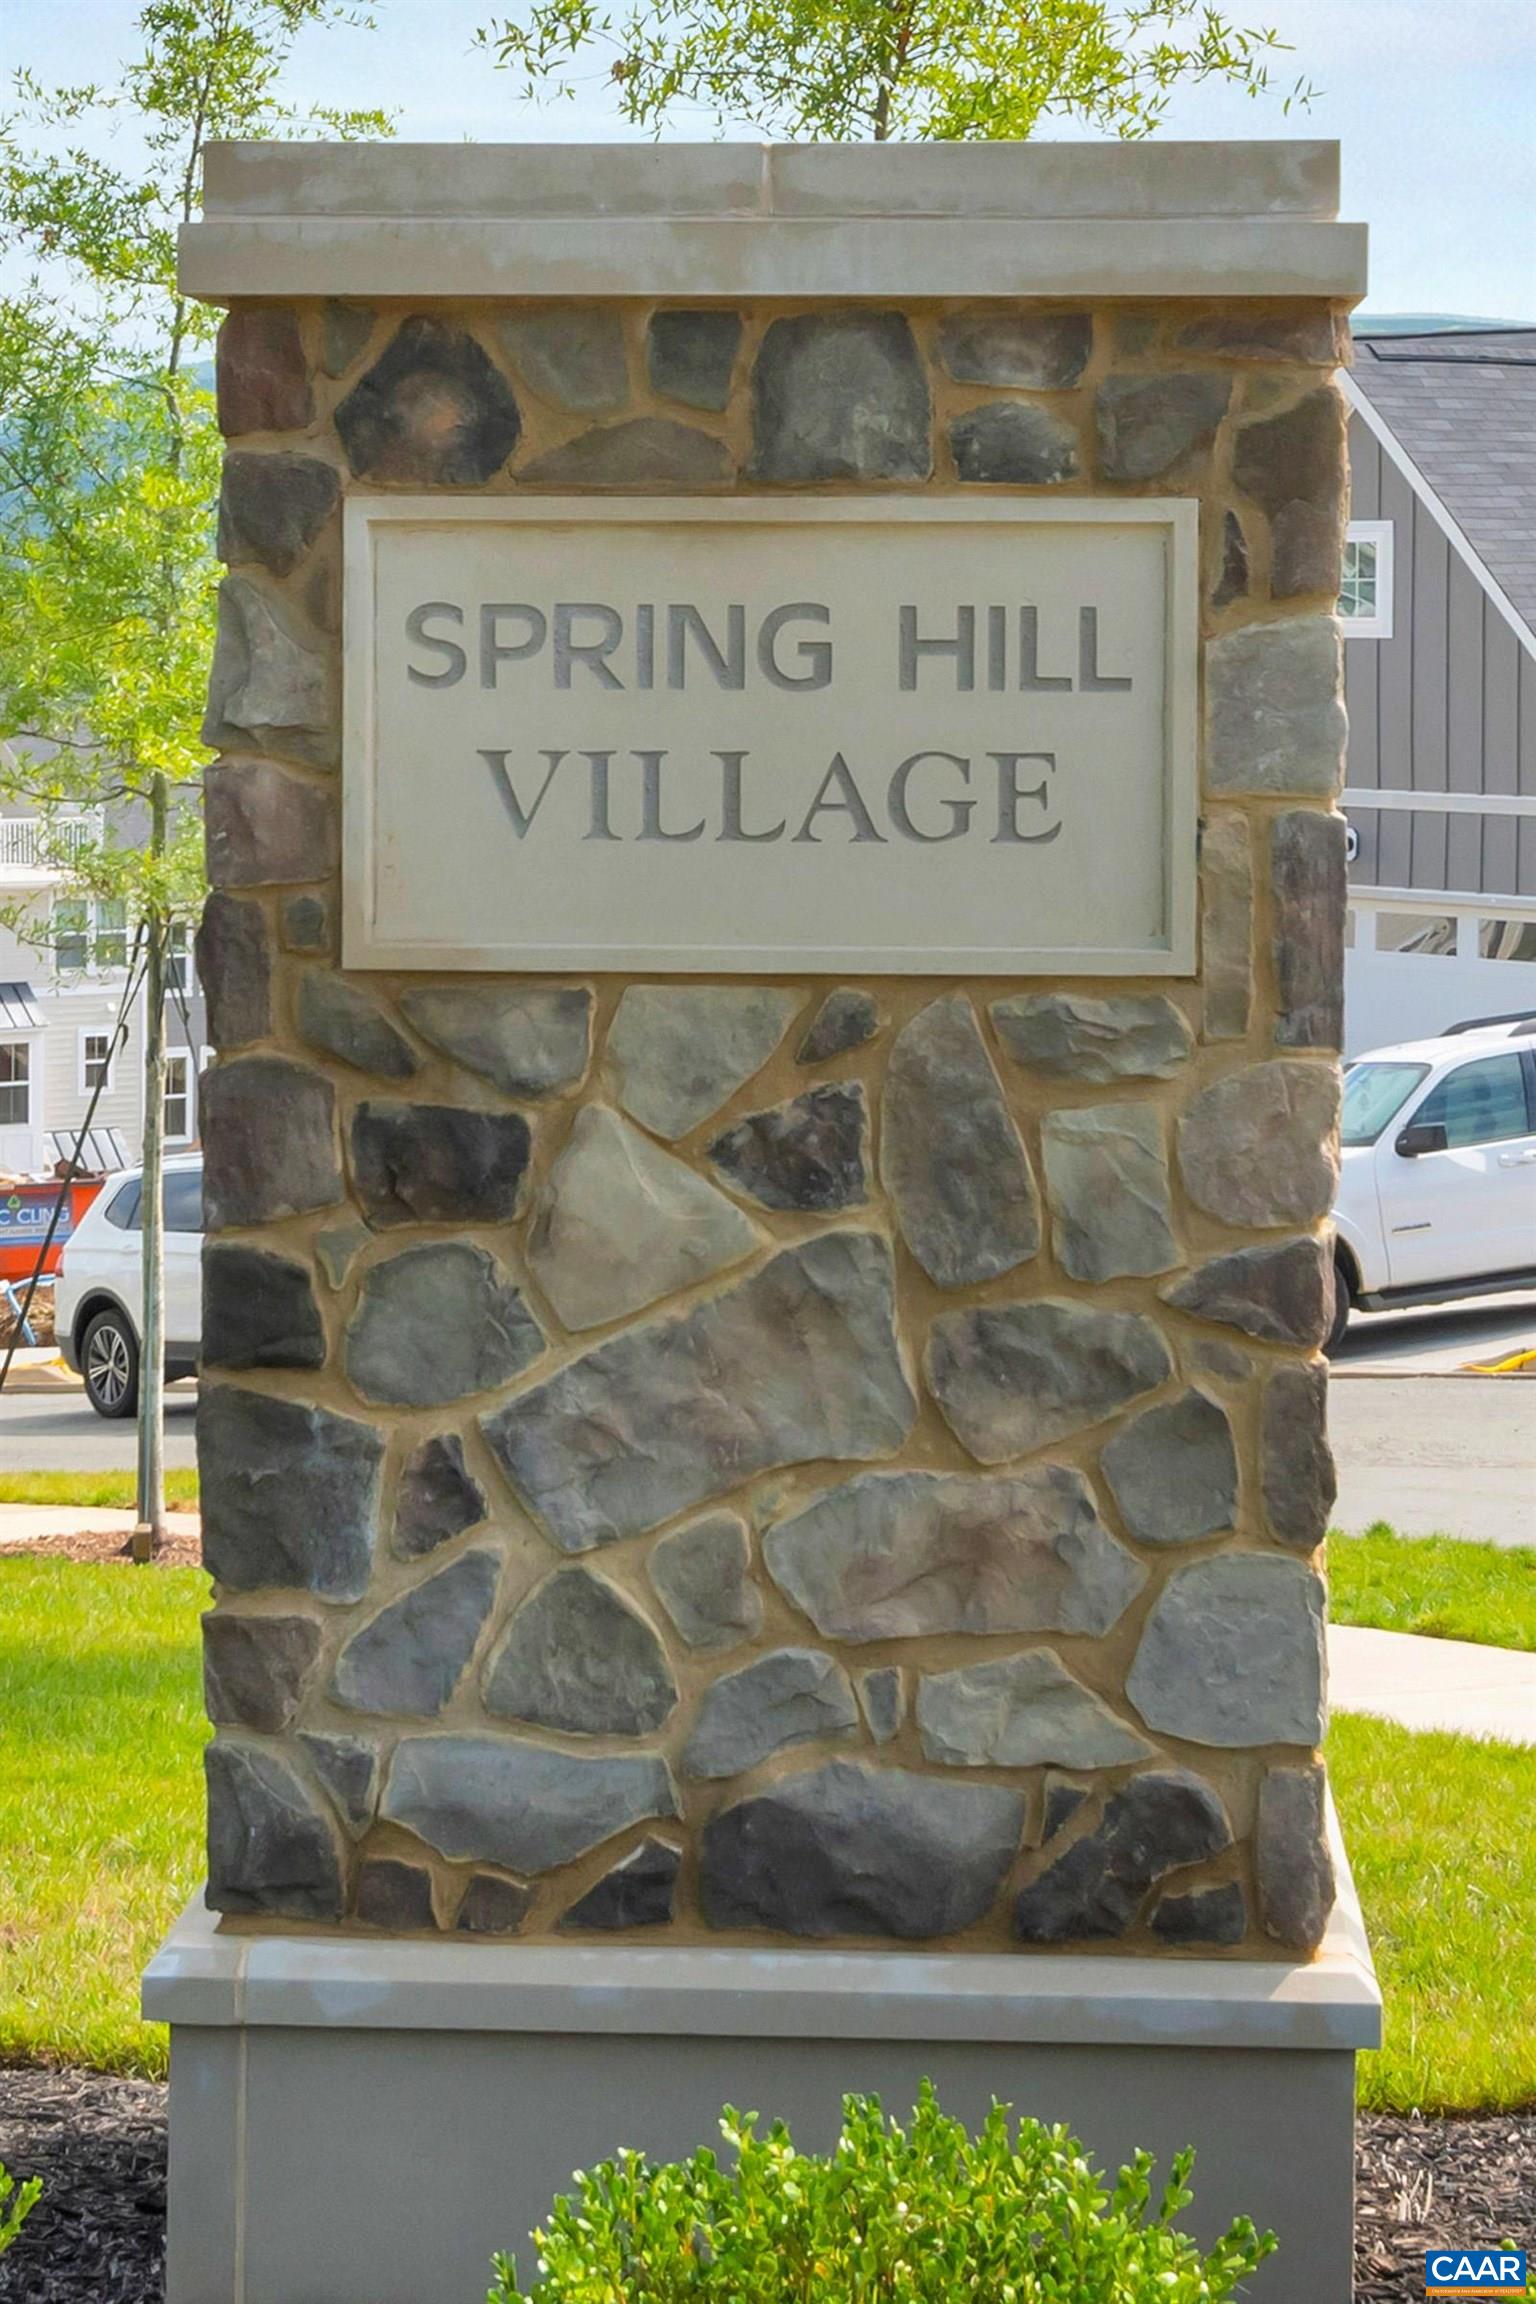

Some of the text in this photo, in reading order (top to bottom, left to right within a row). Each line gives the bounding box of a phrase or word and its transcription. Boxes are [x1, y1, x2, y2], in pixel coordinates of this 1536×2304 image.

[405, 601, 1133, 693] SPRING HILL
[475, 748, 1063, 845] VILLAGE
